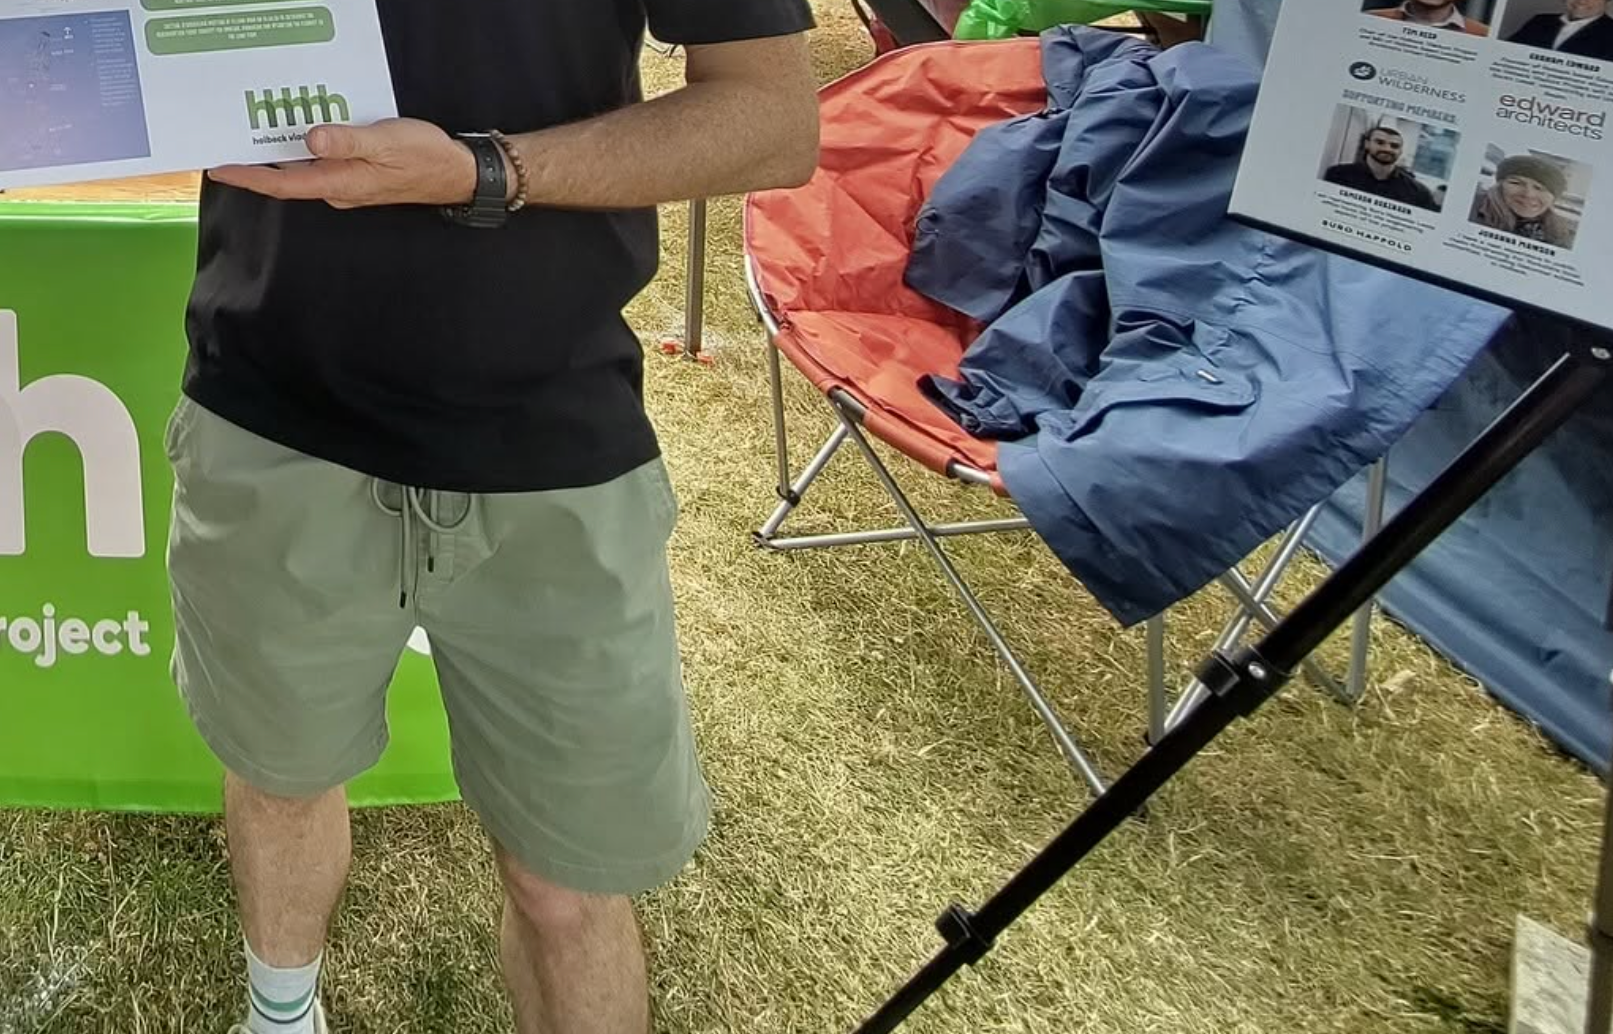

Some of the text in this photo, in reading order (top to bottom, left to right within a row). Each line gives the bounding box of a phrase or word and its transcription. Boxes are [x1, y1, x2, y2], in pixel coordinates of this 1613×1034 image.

[1378, 76, 1467, 103] WILDERNESS
[1380, 67, 1428, 84] URBAN
[1496, 107, 1603, 140] architects
[1499, 94, 1606, 128] edward
[252, 132, 287, 146] holbeck
[1321, 219, 1412, 251] BURO HAPPOLD
